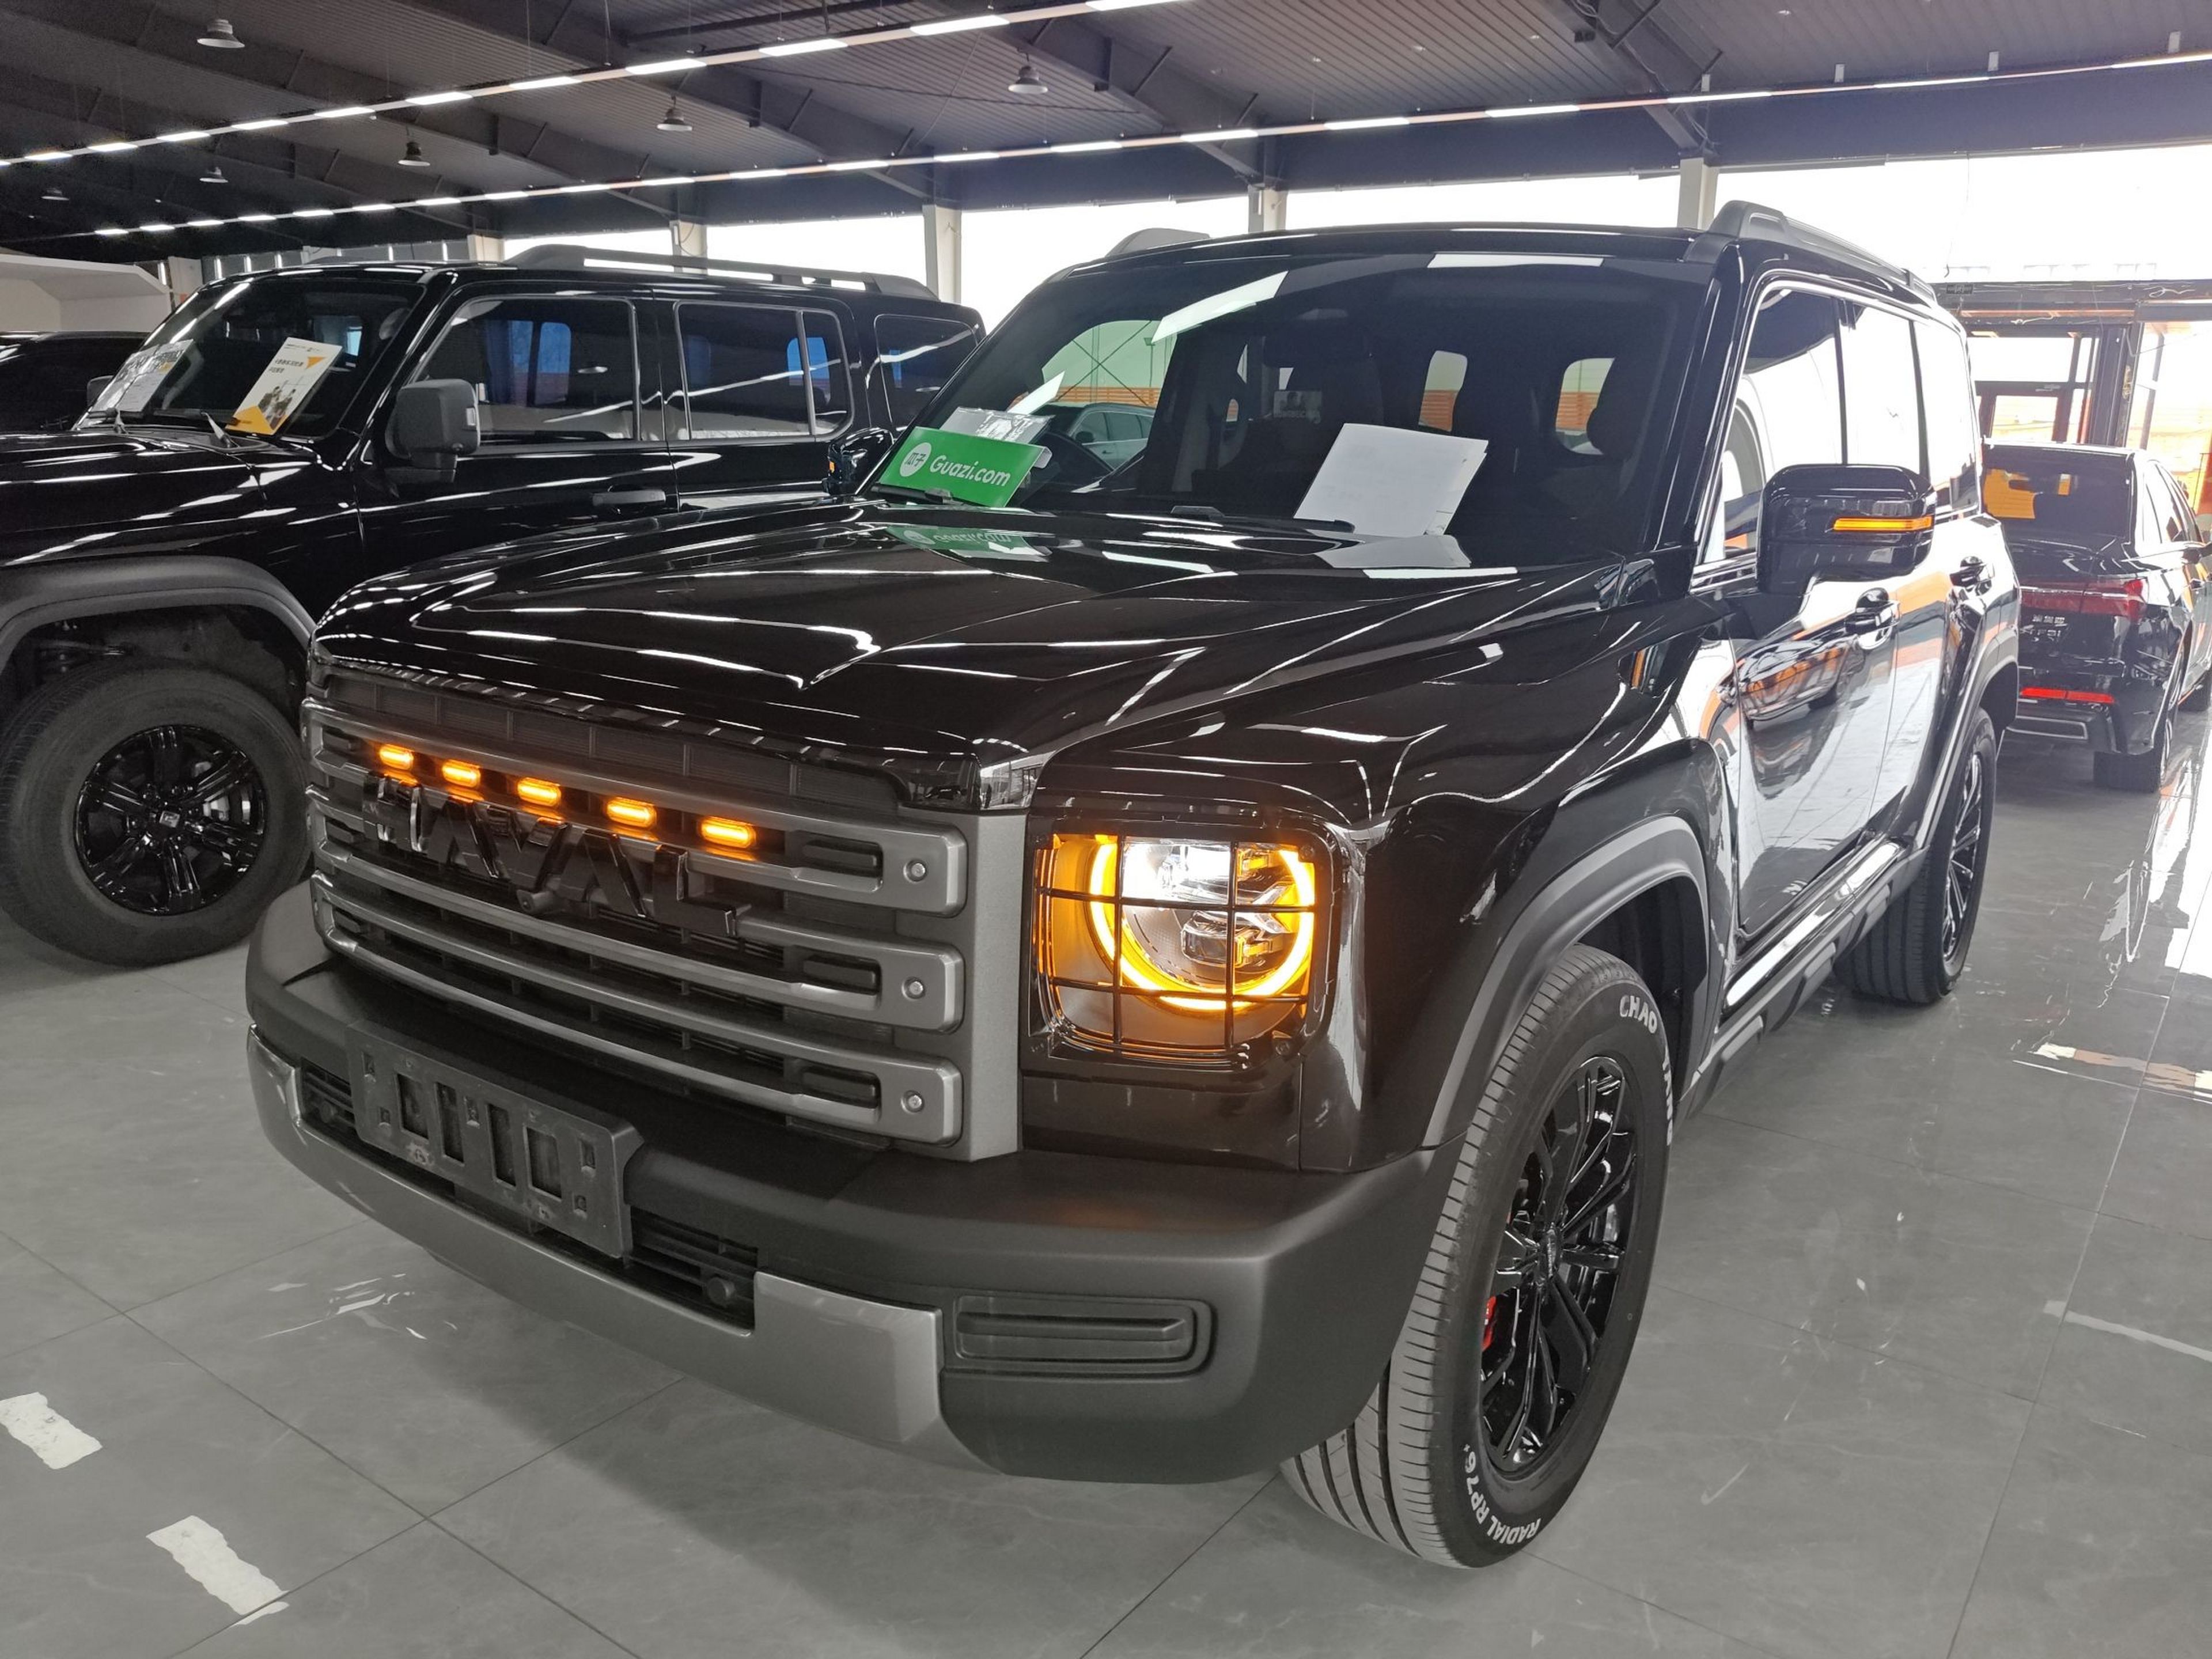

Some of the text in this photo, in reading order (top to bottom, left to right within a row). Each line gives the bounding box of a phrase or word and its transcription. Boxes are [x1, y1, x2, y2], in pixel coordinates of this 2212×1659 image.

[930, 455, 1010, 486] Guazi.com
[362, 771, 737, 936] HAVAL
[1487, 1515, 1541, 1545] RADIAL
